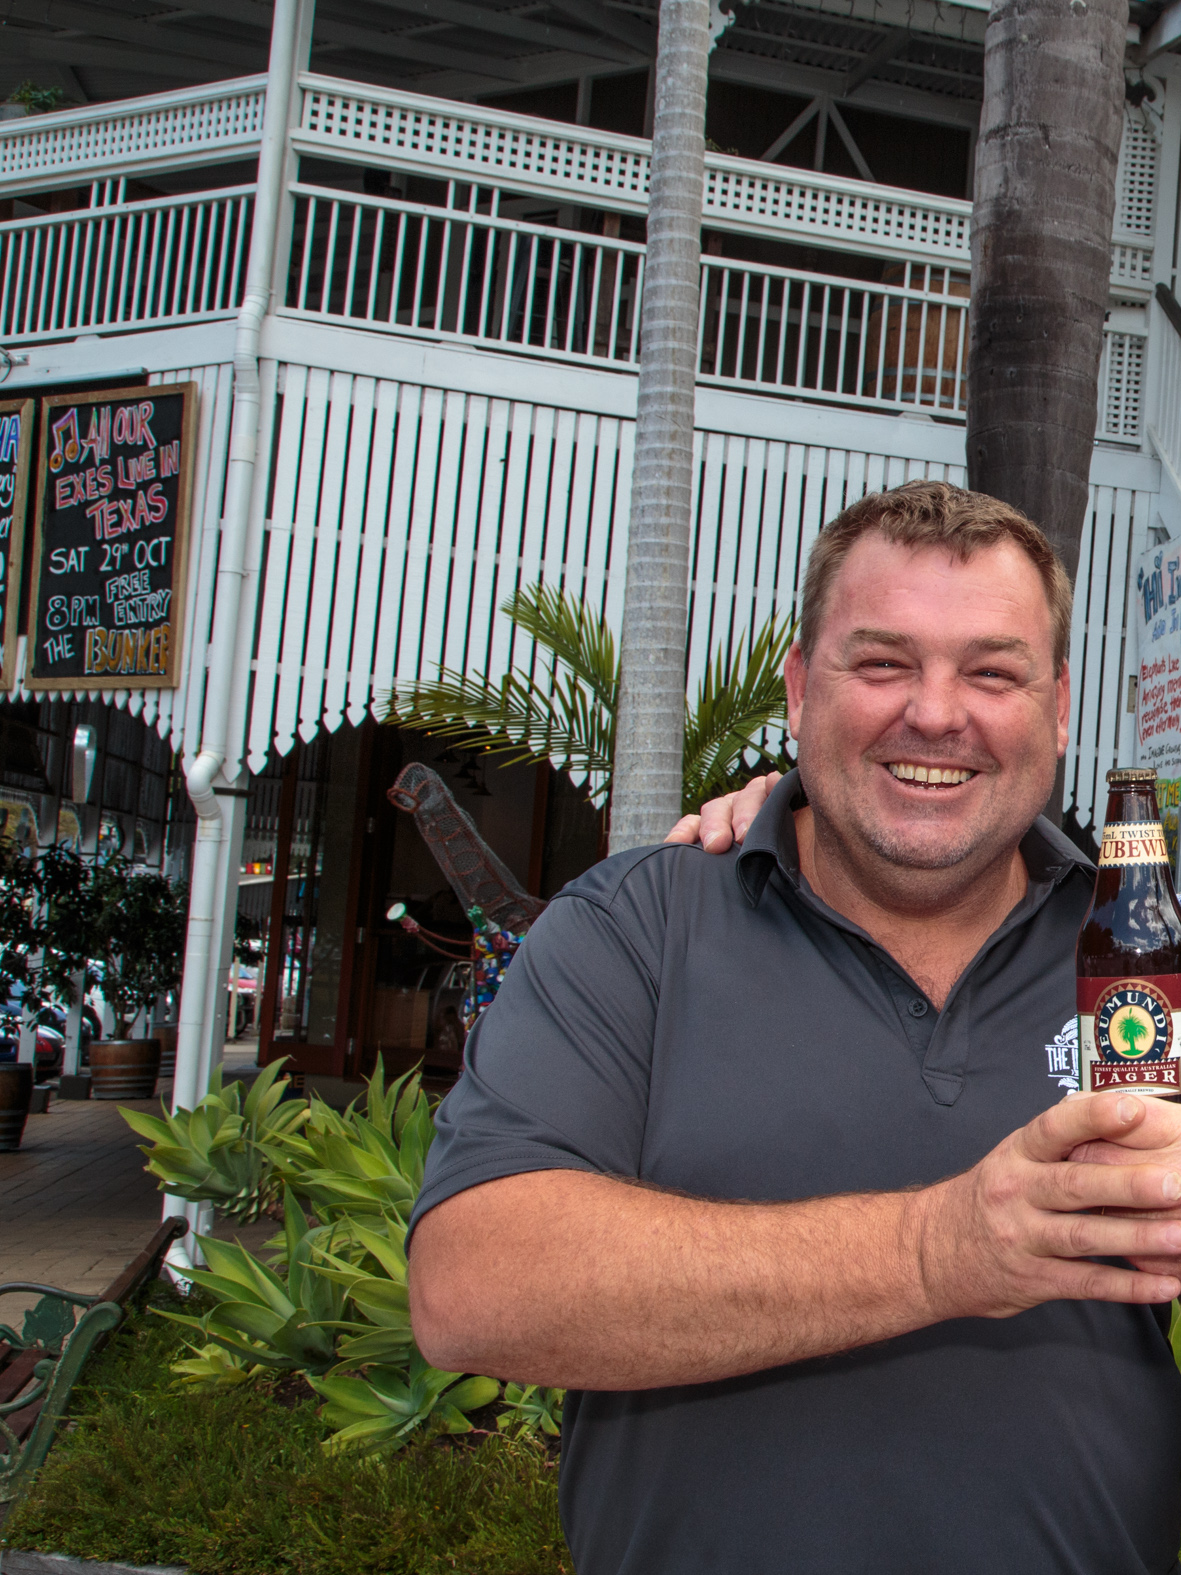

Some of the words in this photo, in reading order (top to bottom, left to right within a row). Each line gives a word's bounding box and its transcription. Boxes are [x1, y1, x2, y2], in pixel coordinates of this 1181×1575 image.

[113, 401, 158, 450] OUR
[56, 465, 114, 510] EXES
[118, 451, 157, 490] LIVE
[160, 440, 181, 478] IN
[86, 484, 169, 540] TEXAS
[50, 546, 90, 575] SAT
[134, 537, 172, 569] OCT
[106, 570, 151, 604] FREE
[114, 589, 173, 626] ENTRY
[43, 634, 75, 664] THE
[85, 622, 171, 675] BUNKER
[1166, 781, 1180, 807] ME
[1119, 829, 1155, 839] TWIST
[1099, 991, 1167, 1047] EUMUNDI
[1045, 1047, 1071, 1073] THE
[1095, 1069, 1178, 1087] LAGER
[1140, 1063, 1177, 1072] AUSTRALIAN
